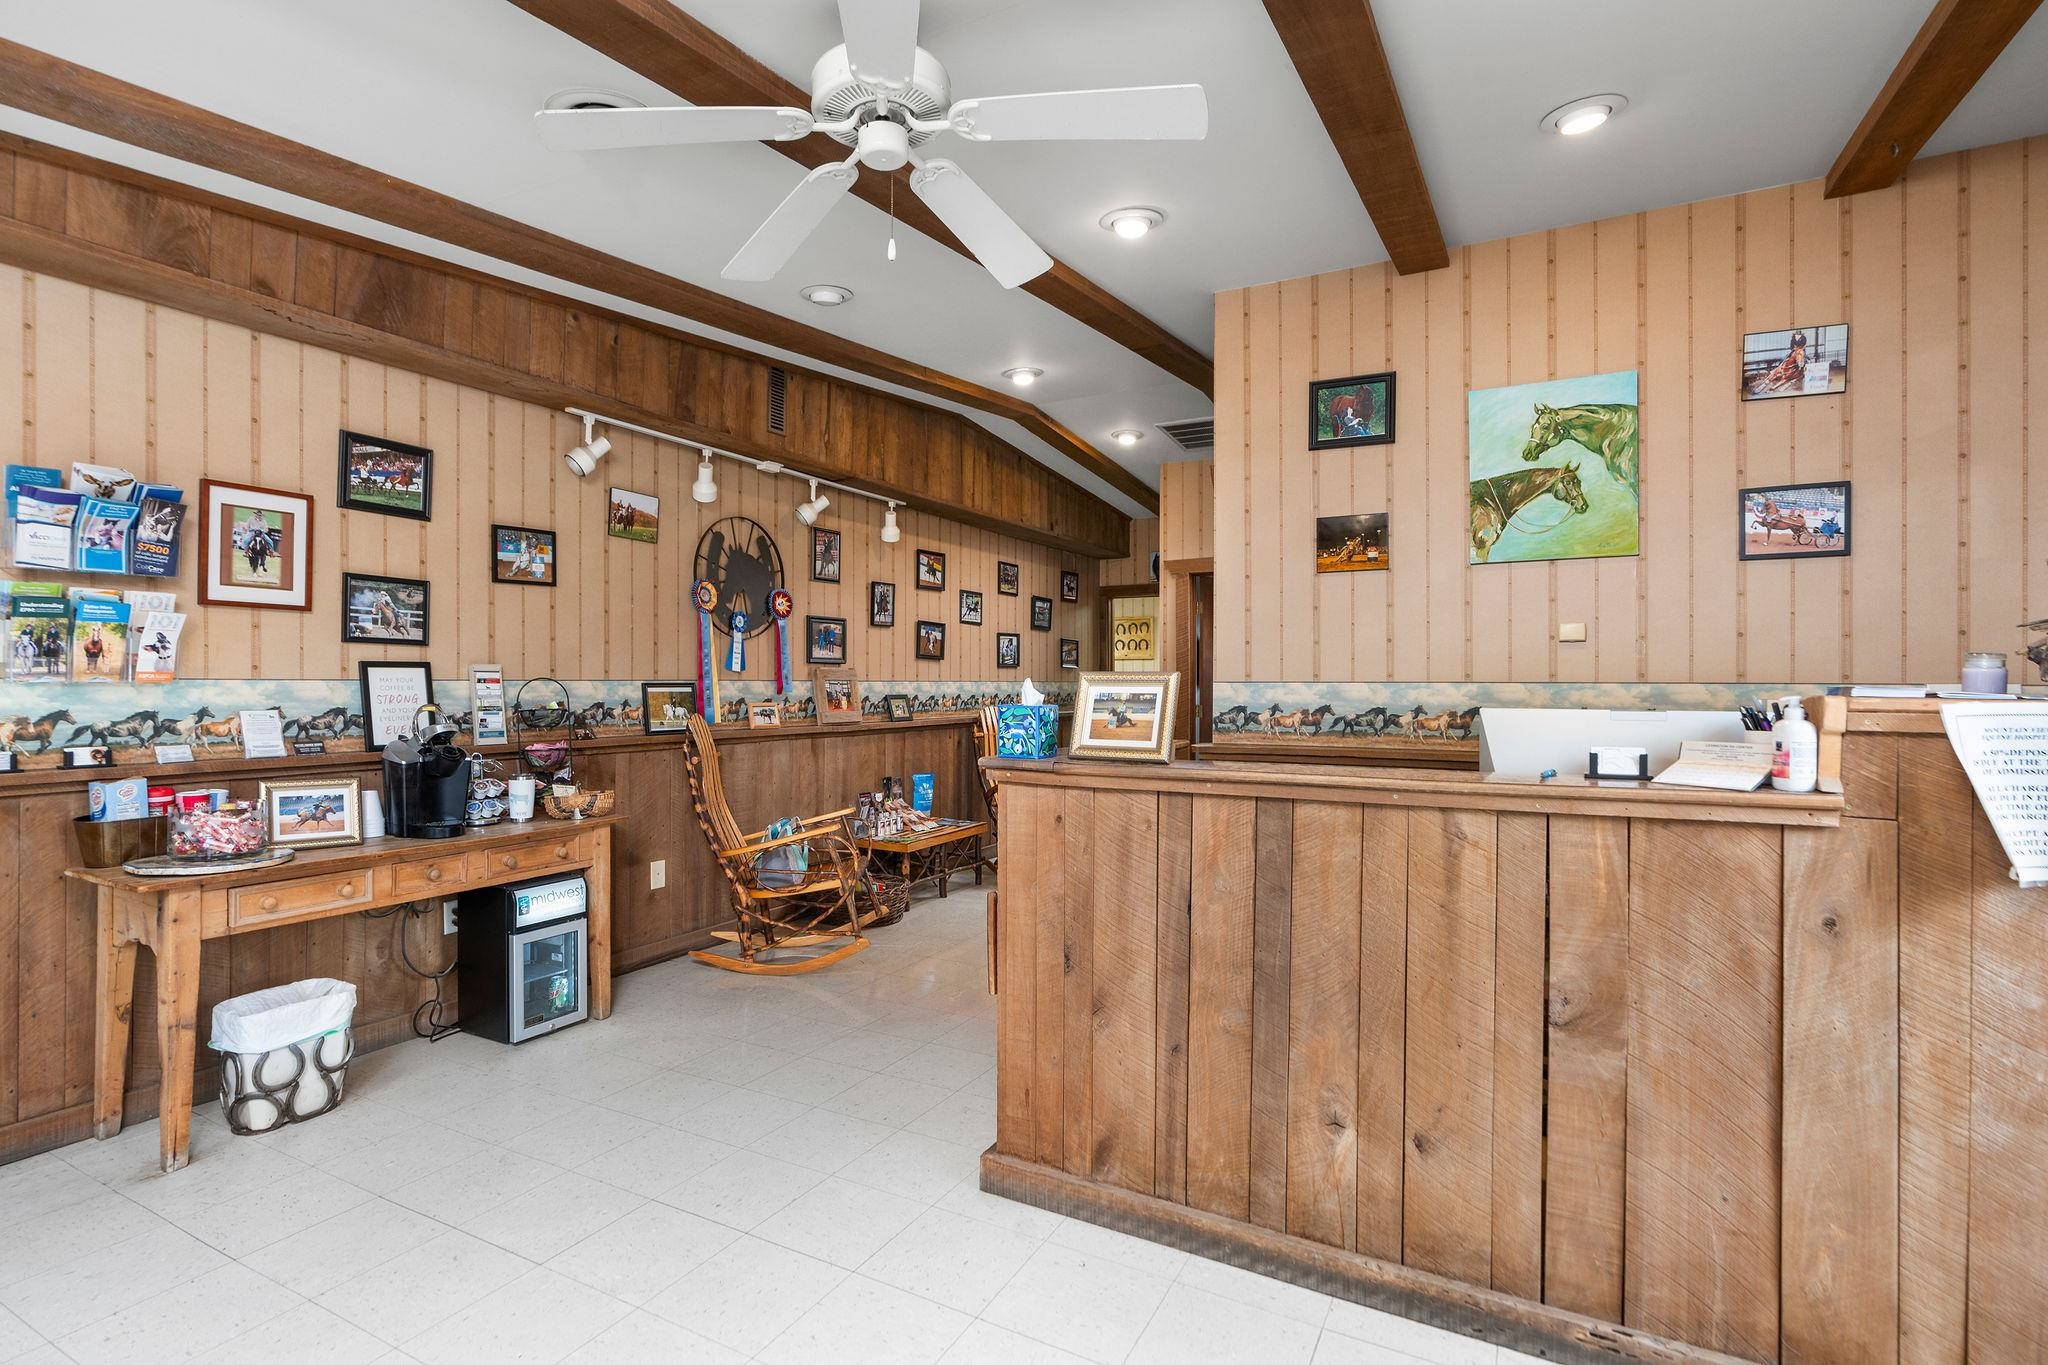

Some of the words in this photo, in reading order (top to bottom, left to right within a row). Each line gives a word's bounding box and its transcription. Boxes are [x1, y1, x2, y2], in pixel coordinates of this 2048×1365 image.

[137, 542, 170, 555] $7500
[376, 693, 419, 705] STRONG
[530, 884, 584, 906] midwest
